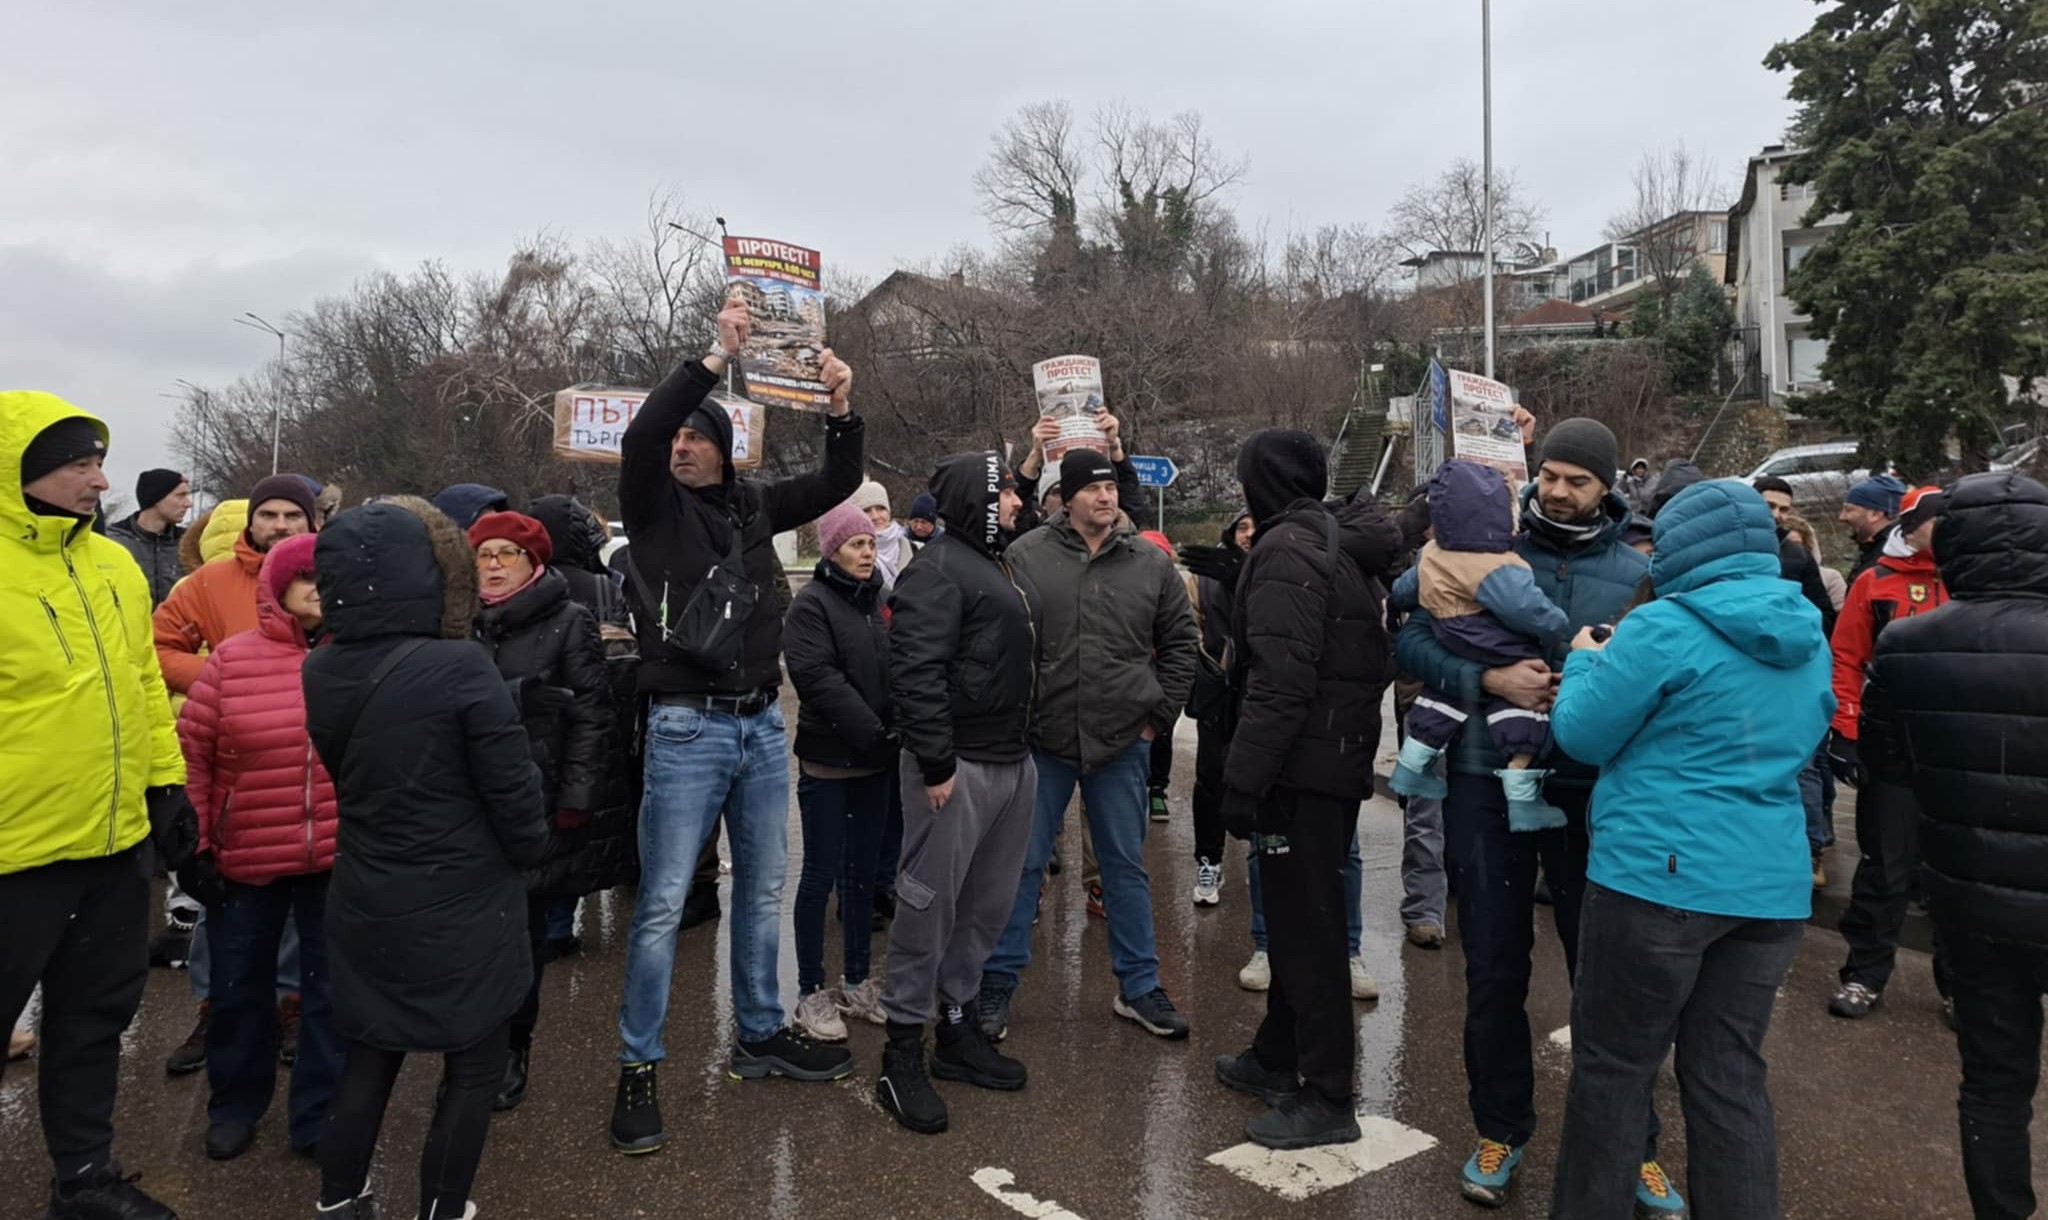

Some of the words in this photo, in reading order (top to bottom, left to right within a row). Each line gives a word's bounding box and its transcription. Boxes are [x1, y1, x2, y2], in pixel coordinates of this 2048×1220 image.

[737, 239, 810, 266] ПРОТЕСТ!
[1047, 365, 1092, 379] ПРОТЕСТ
[1463, 383, 1504, 400] ПРОТЕСТ
[986, 455, 1000, 493] PUMA
[1161, 466, 1168, 477] 3
[986, 502, 1000, 544] PUMA
